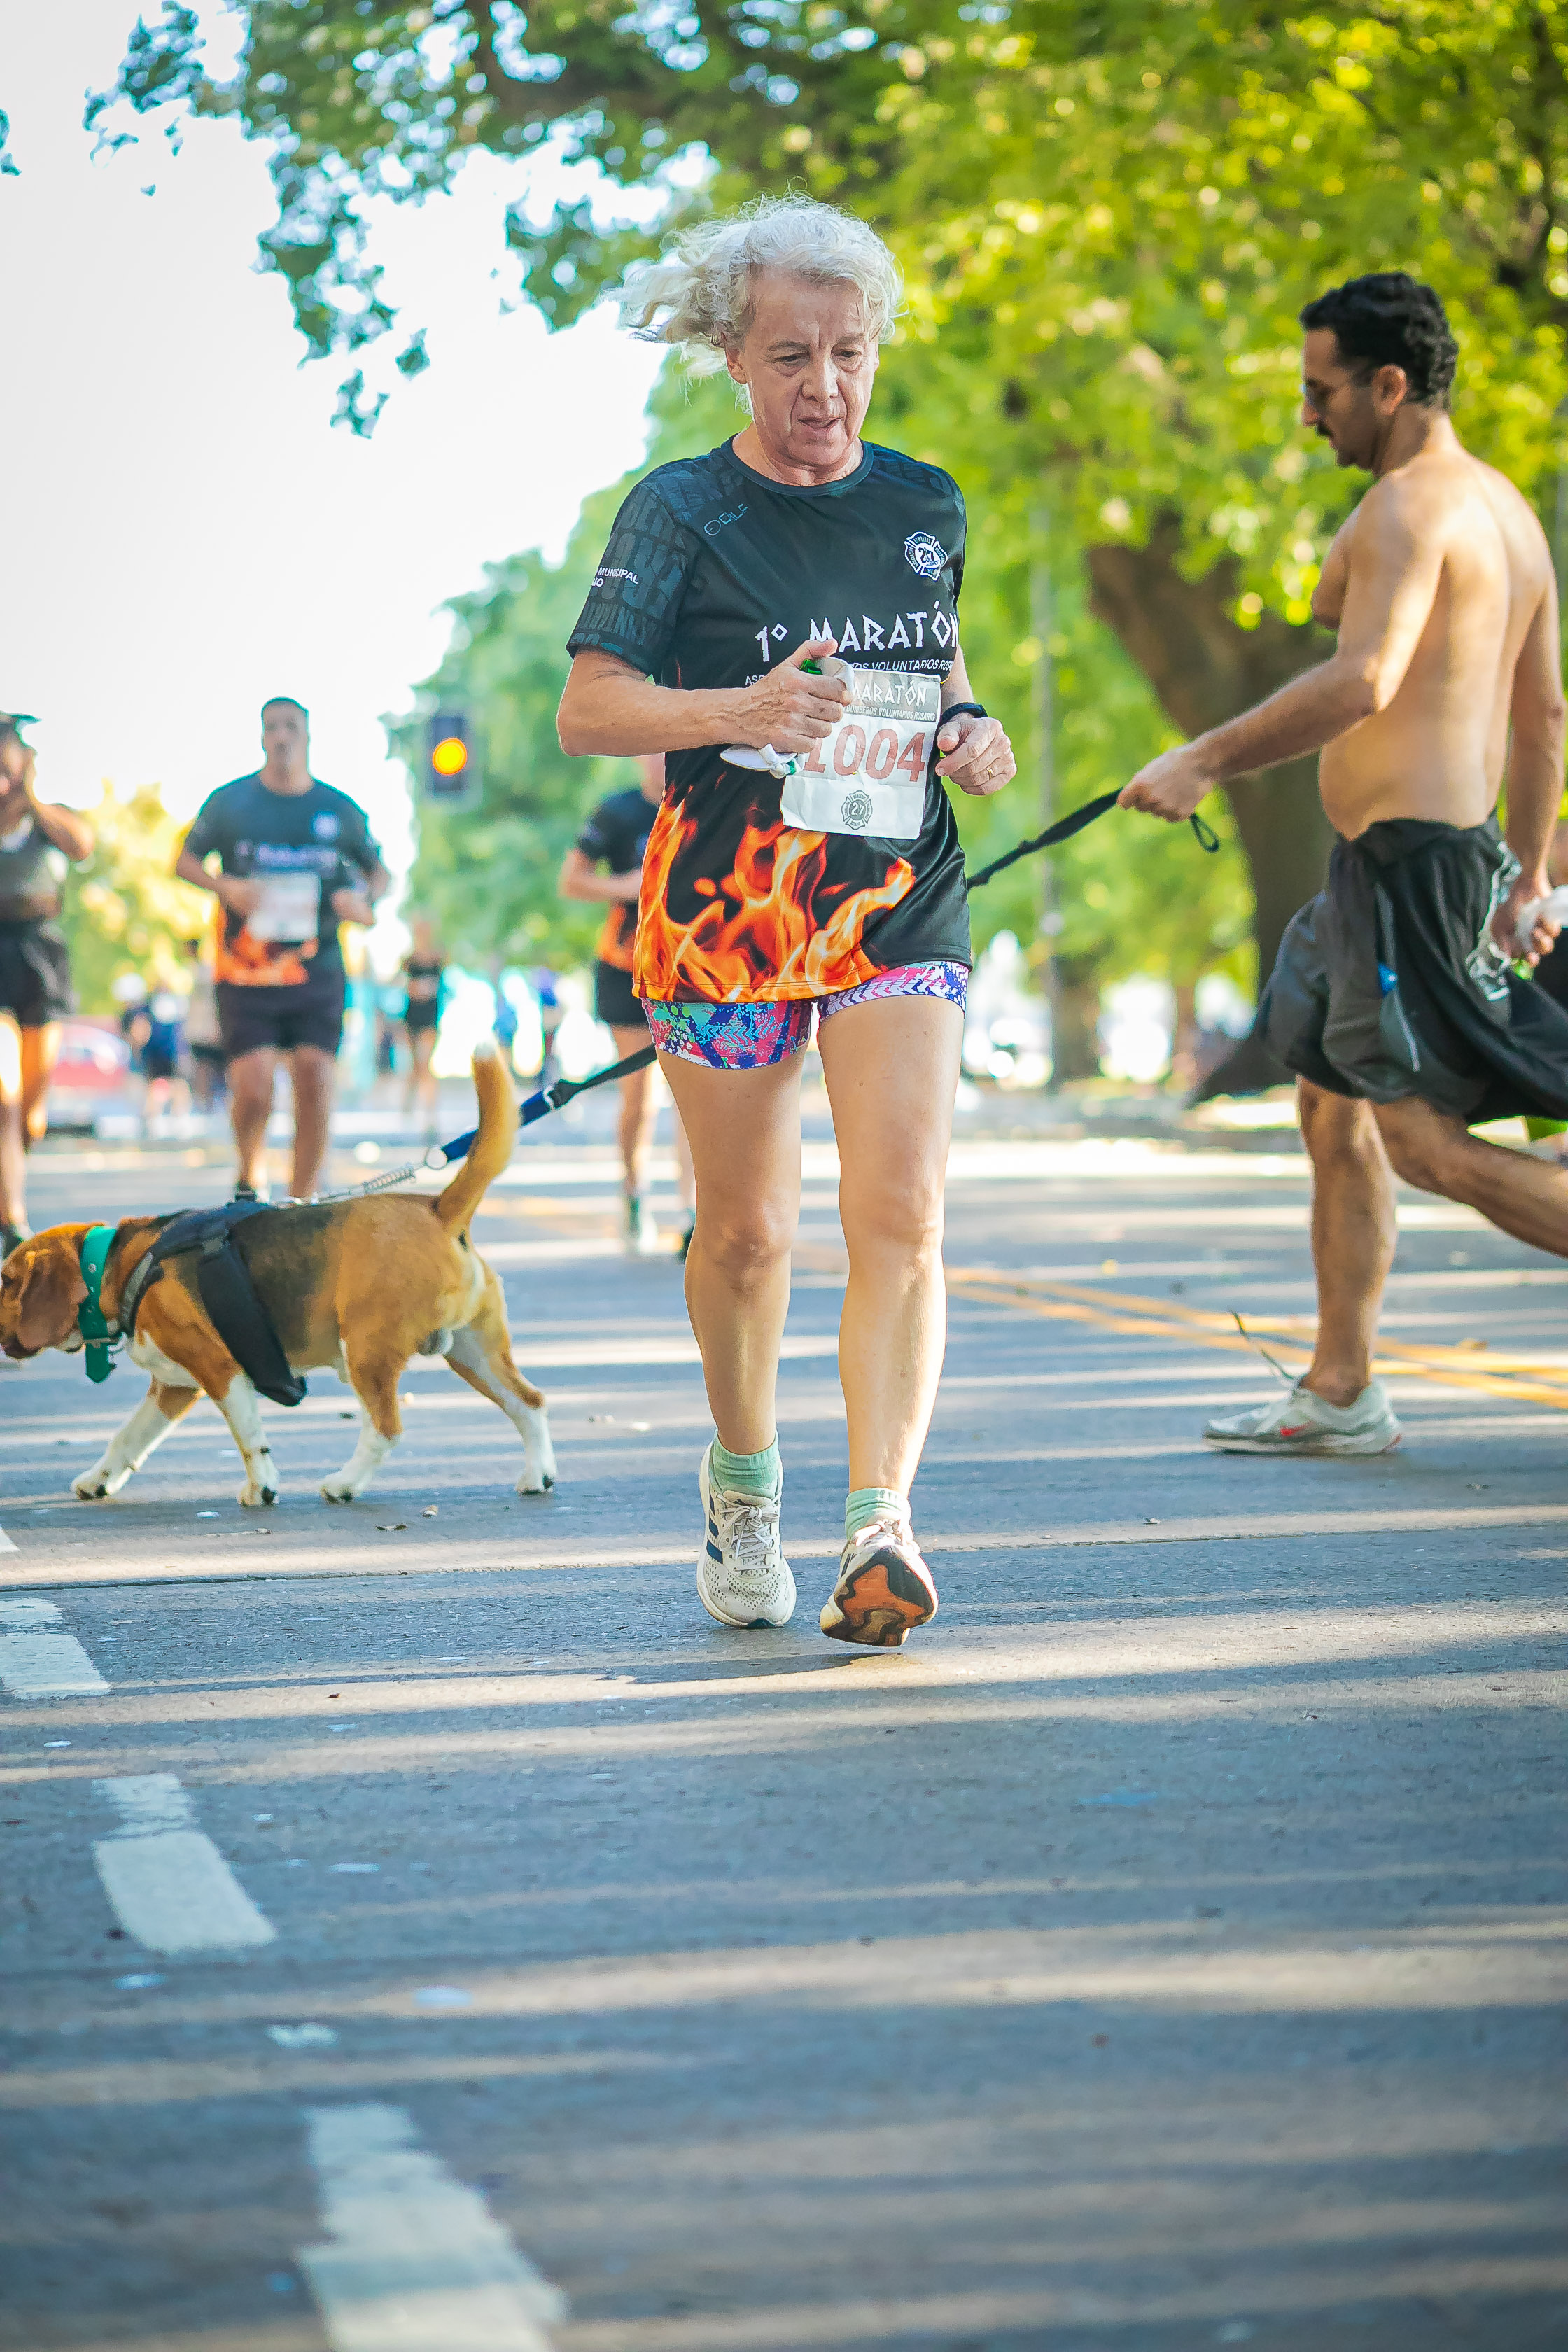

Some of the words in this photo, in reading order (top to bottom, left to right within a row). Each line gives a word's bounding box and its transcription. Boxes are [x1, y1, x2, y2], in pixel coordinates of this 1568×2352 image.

[597, 566, 638, 584] MUNICIPAL
[809, 599, 959, 653] MARATÓN
[872, 659, 940, 671] VOLUNTARIOS
[846, 704, 878, 715] BOMBEROS
[878, 708, 914, 720] VOLUNTARIOS
[913, 711, 936, 722] ROSARIO
[803, 724, 926, 783] 1004
[850, 802, 865, 816] 27
